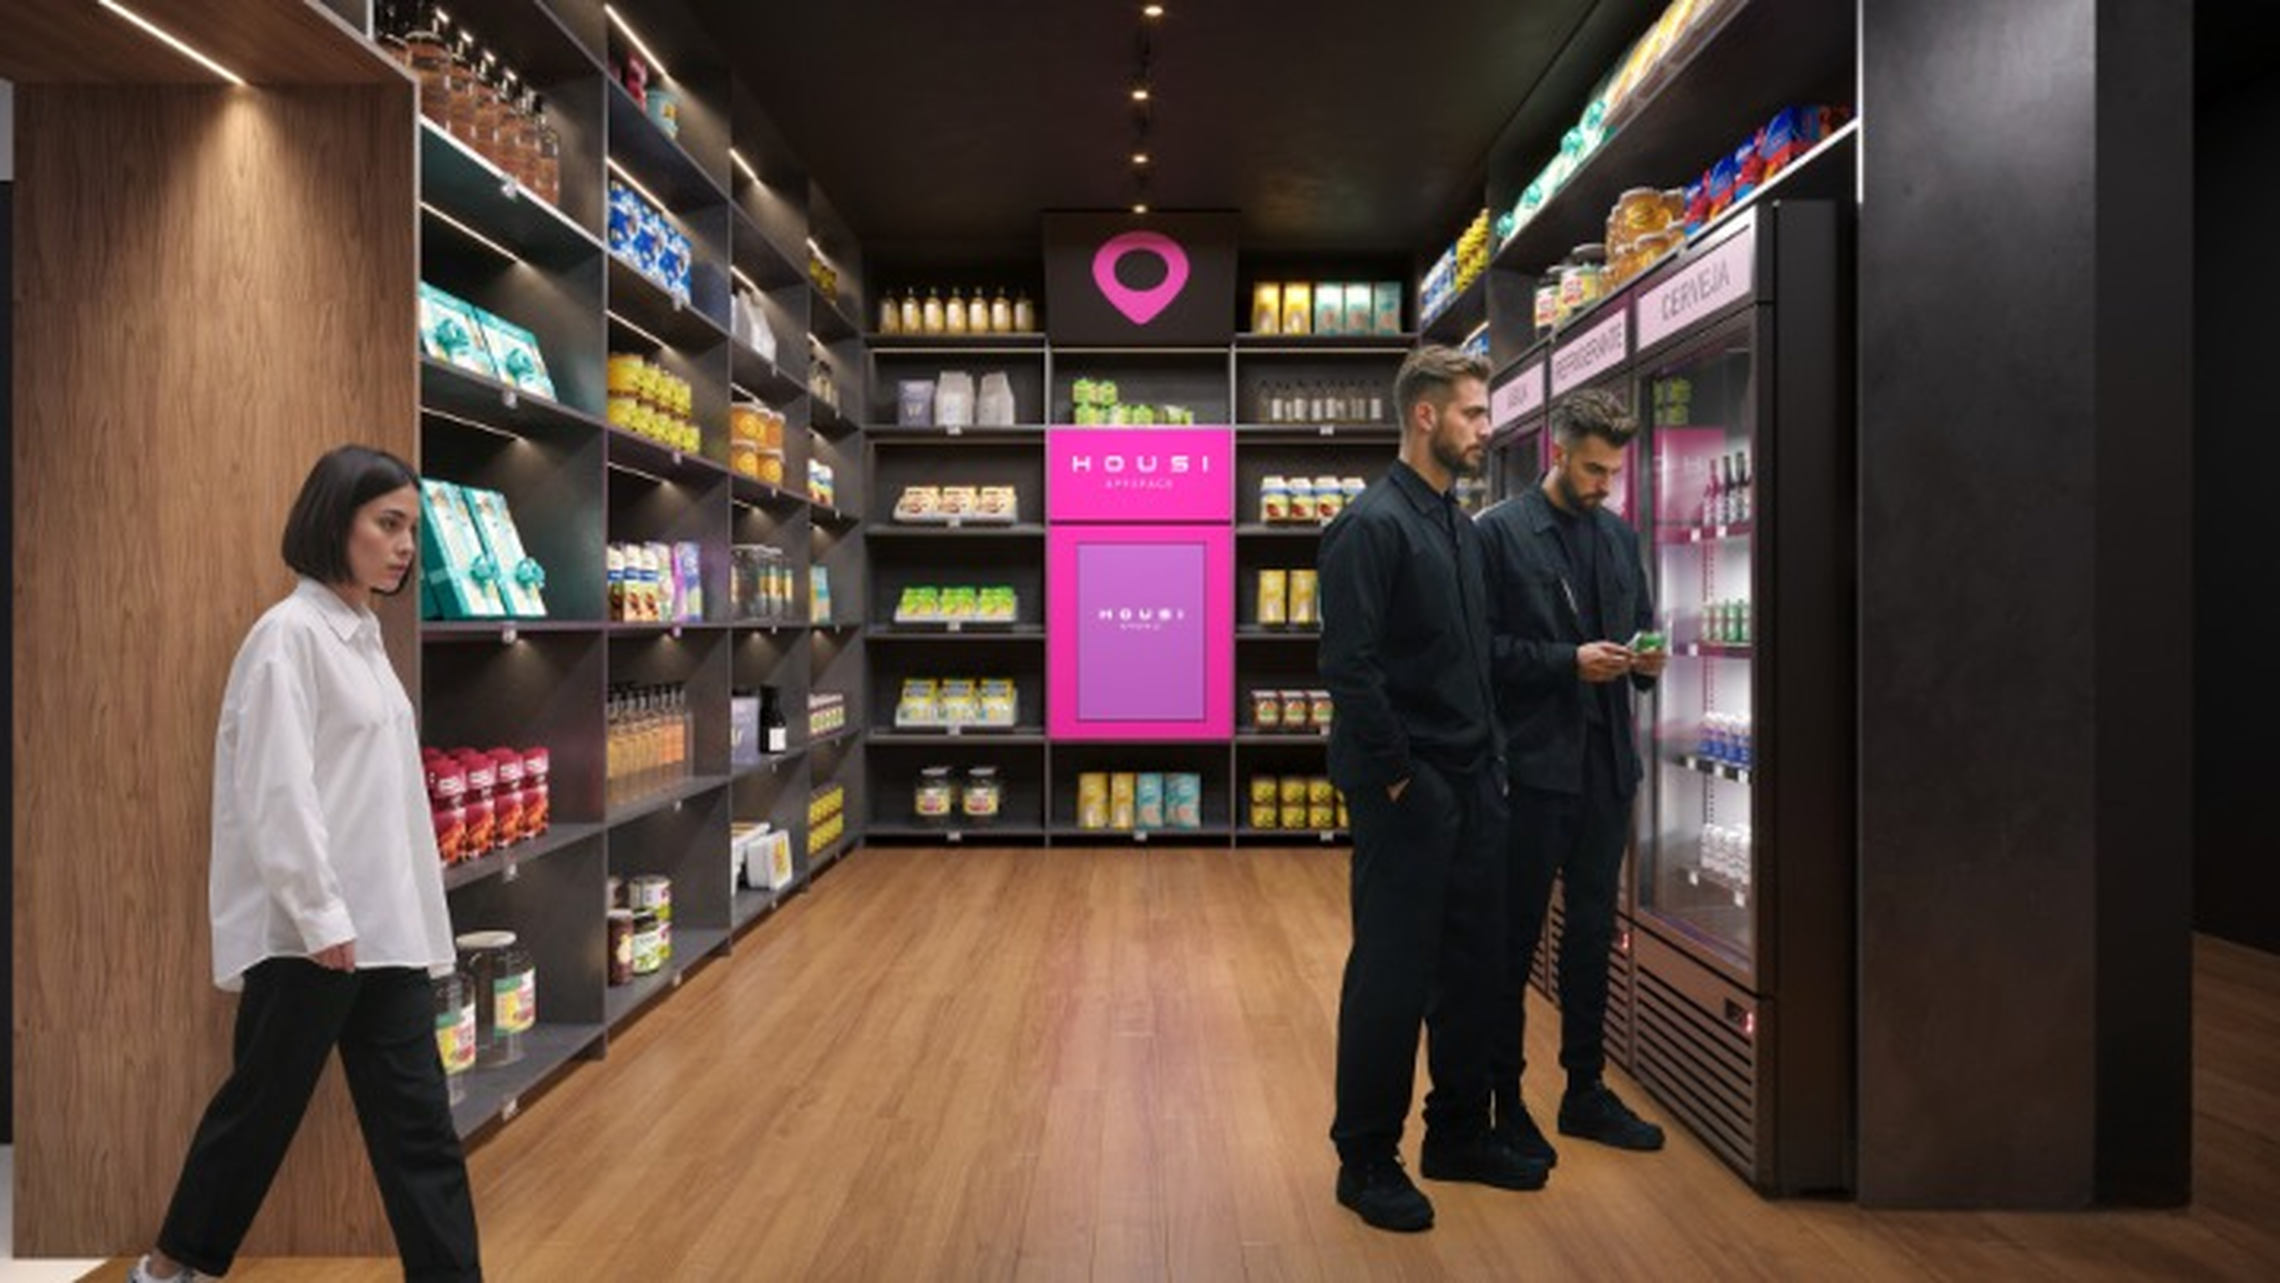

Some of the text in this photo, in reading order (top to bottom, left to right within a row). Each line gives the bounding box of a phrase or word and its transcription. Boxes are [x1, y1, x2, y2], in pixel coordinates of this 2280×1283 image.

[1661, 259, 1731, 321] CERVEJA
[1071, 455, 1209, 473] HOUSI
[1098, 607, 1184, 621] HOUSI
